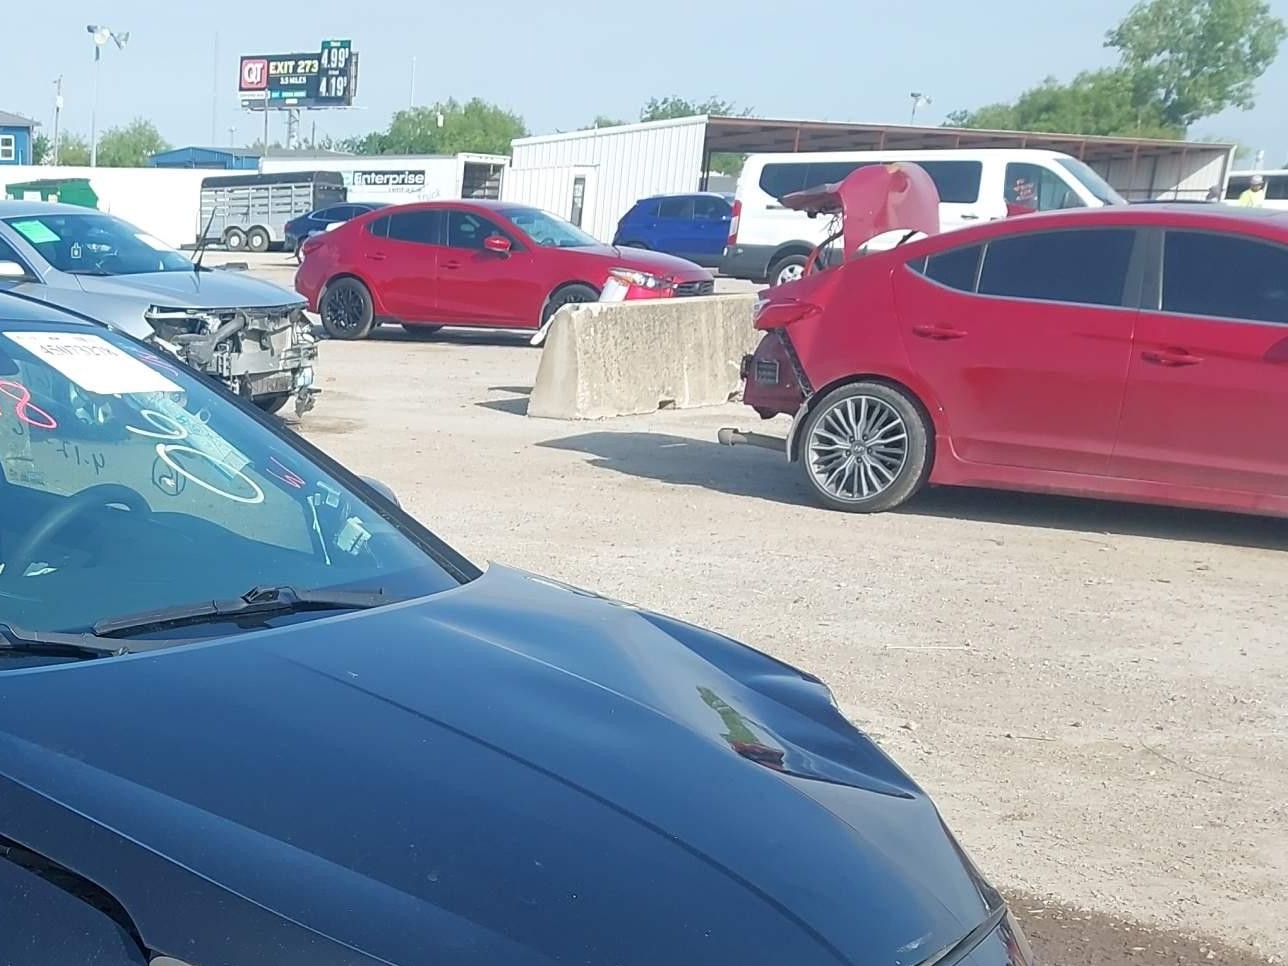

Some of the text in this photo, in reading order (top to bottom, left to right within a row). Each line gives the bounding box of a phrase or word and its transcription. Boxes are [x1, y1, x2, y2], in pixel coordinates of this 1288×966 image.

[244, 63, 264, 85] QT
[269, 61, 295, 74] EXIT
[297, 60, 319, 73] 273
[354, 171, 424, 185] Enterprise
